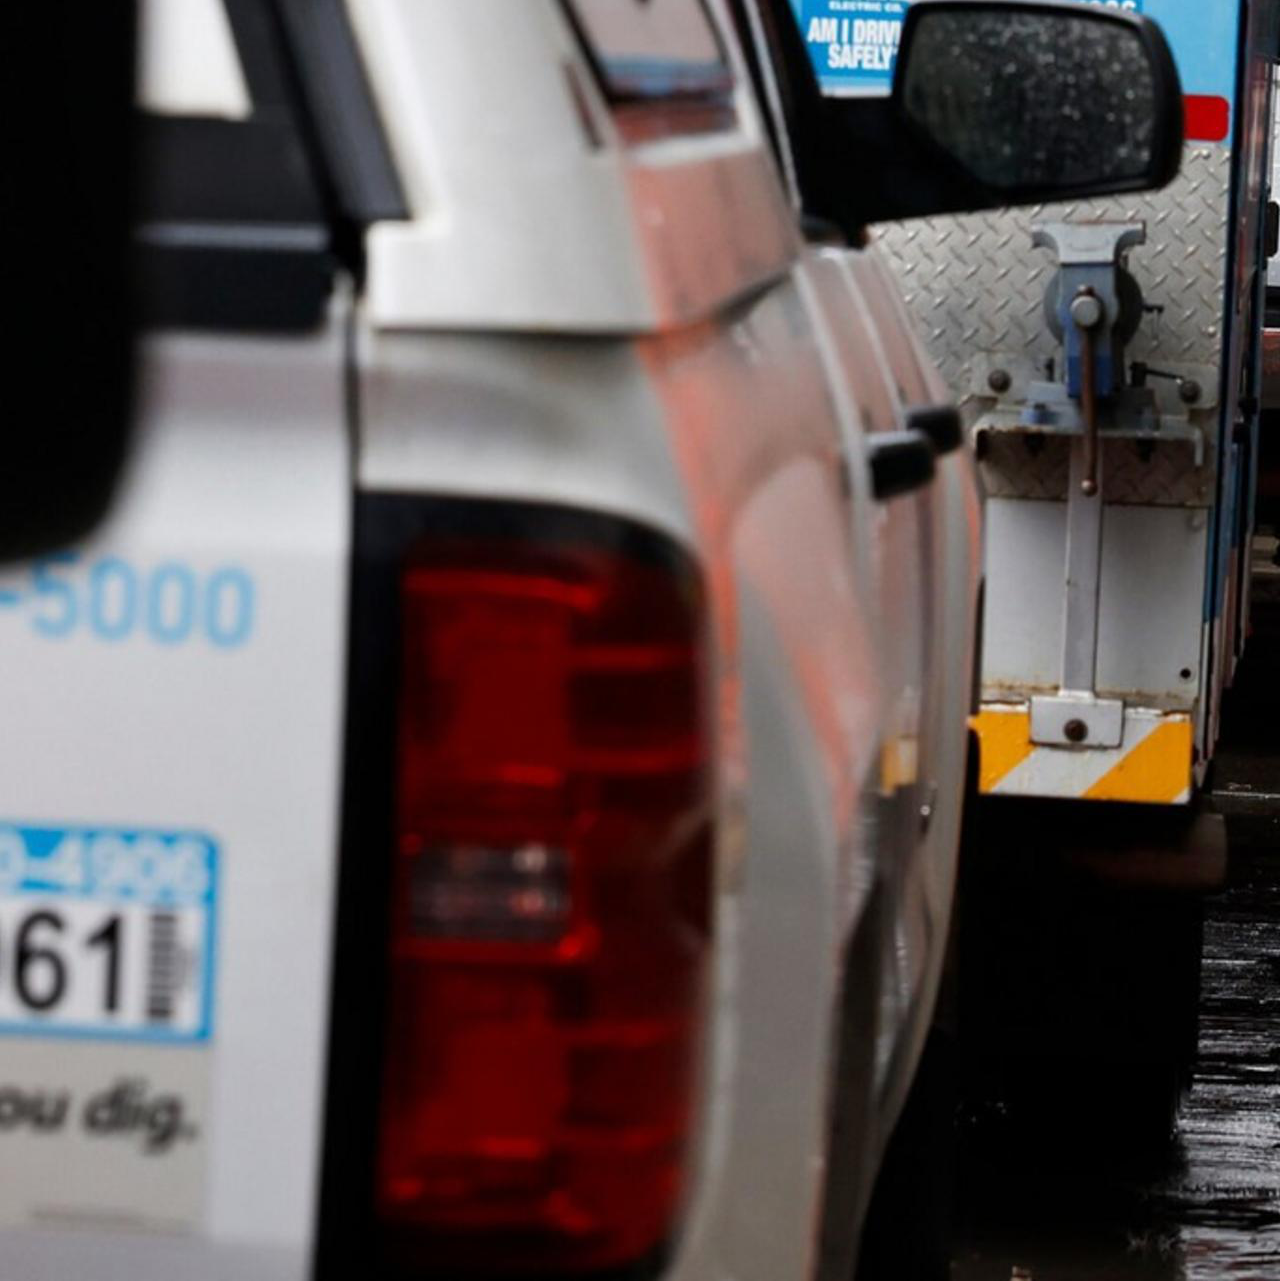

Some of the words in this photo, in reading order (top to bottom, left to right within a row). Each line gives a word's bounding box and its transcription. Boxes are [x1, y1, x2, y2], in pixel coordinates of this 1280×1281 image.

[808, 18, 837, 43] AM
[841, 18, 849, 44] I
[82, 1076, 200, 1156] dig.
